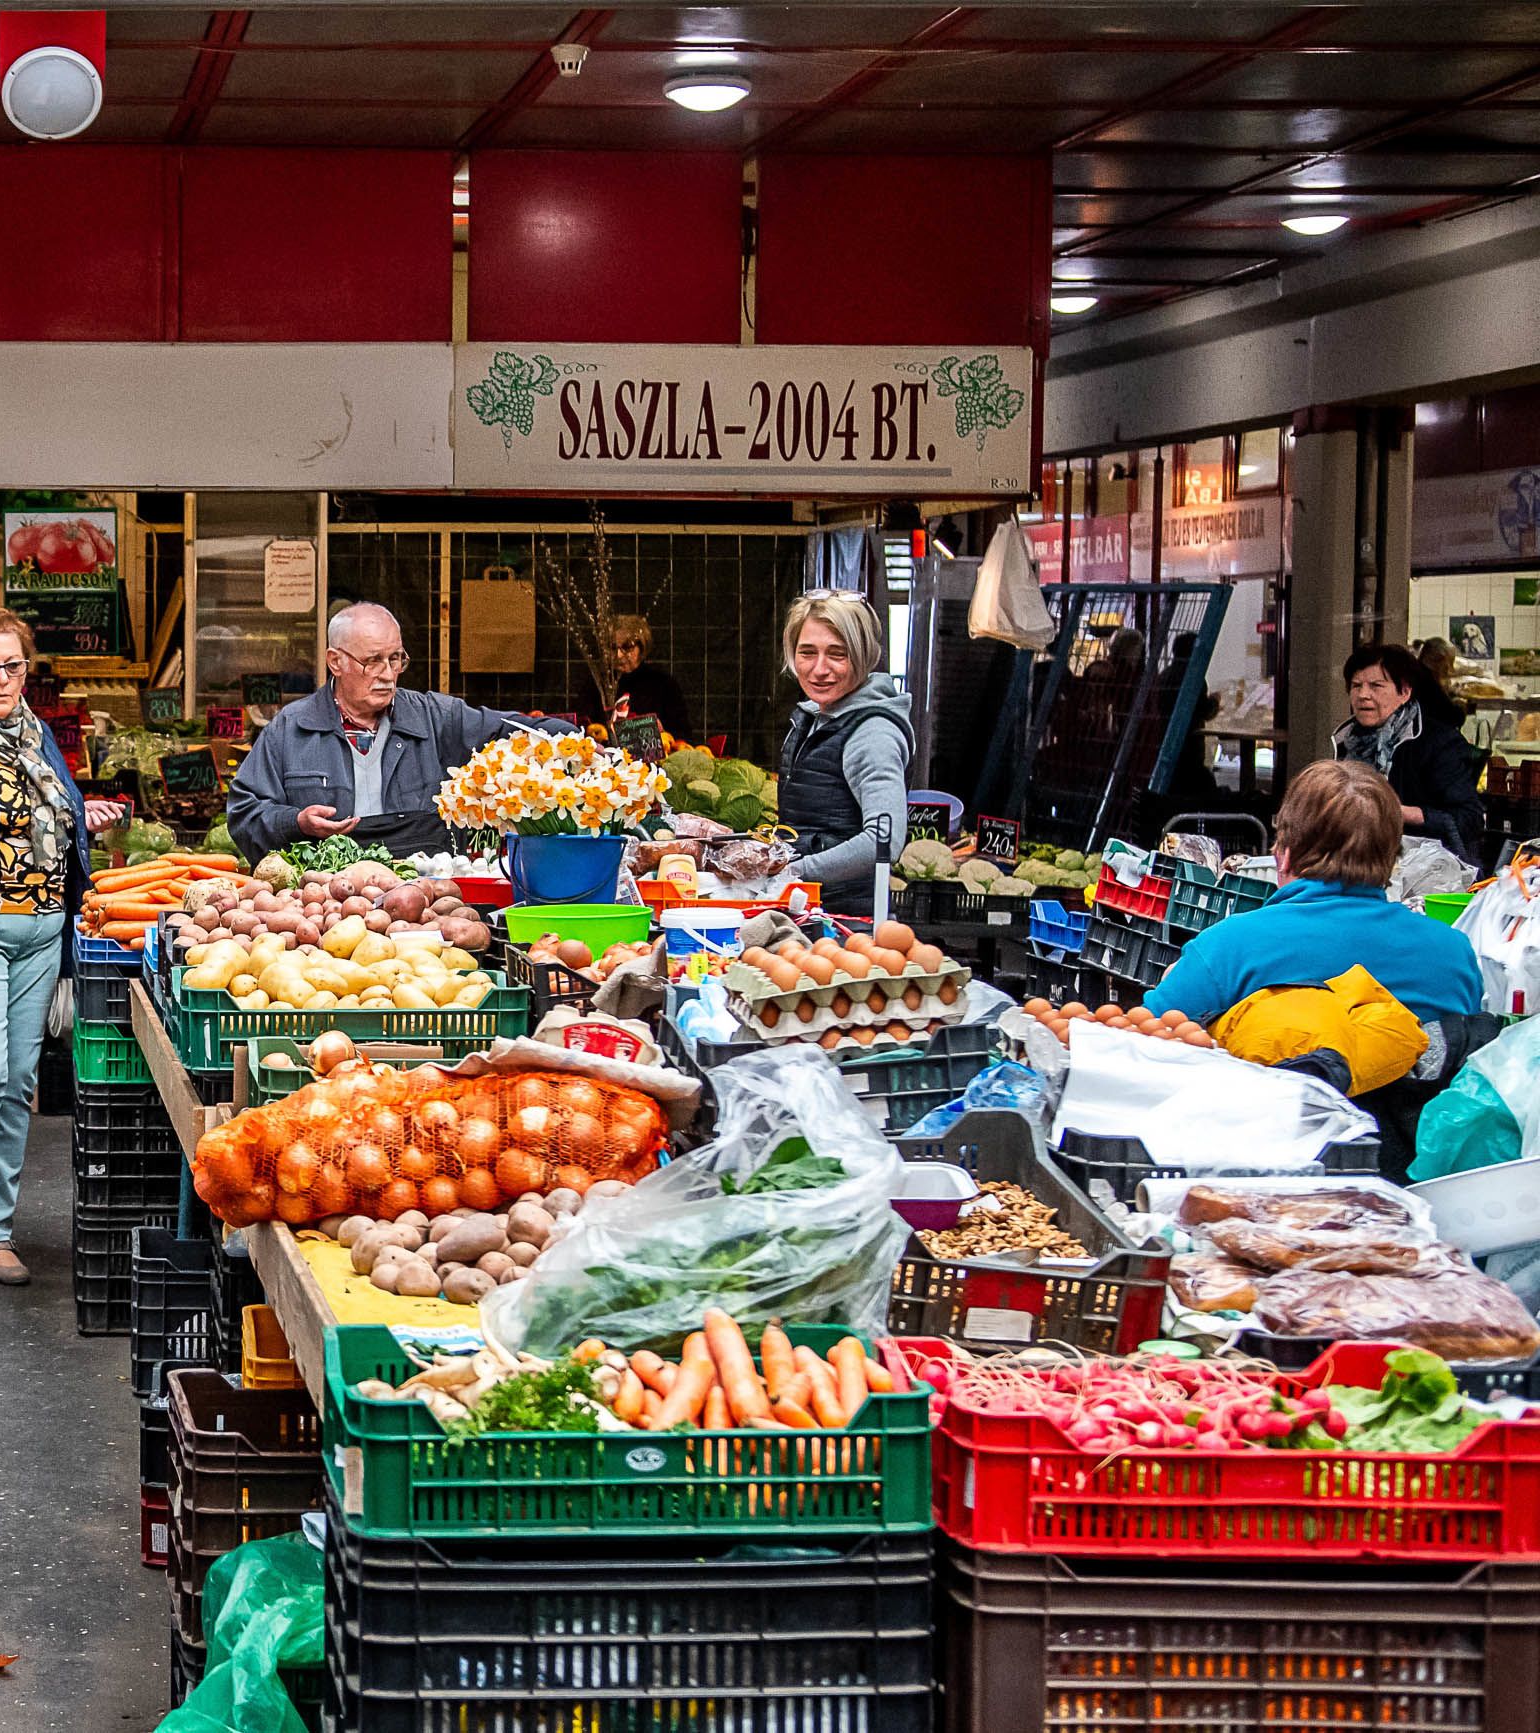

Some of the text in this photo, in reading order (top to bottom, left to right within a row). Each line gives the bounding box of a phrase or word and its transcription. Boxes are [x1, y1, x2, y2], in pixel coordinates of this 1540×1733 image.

[558, 378, 937, 462] SASZLA-2004 BT.
[990, 477, 1019, 489] R-30
[1070, 527, 1124, 567] TELBÁR
[9, 571, 112, 589] PARADICSOM
[981, 831, 1011, 857] 240
